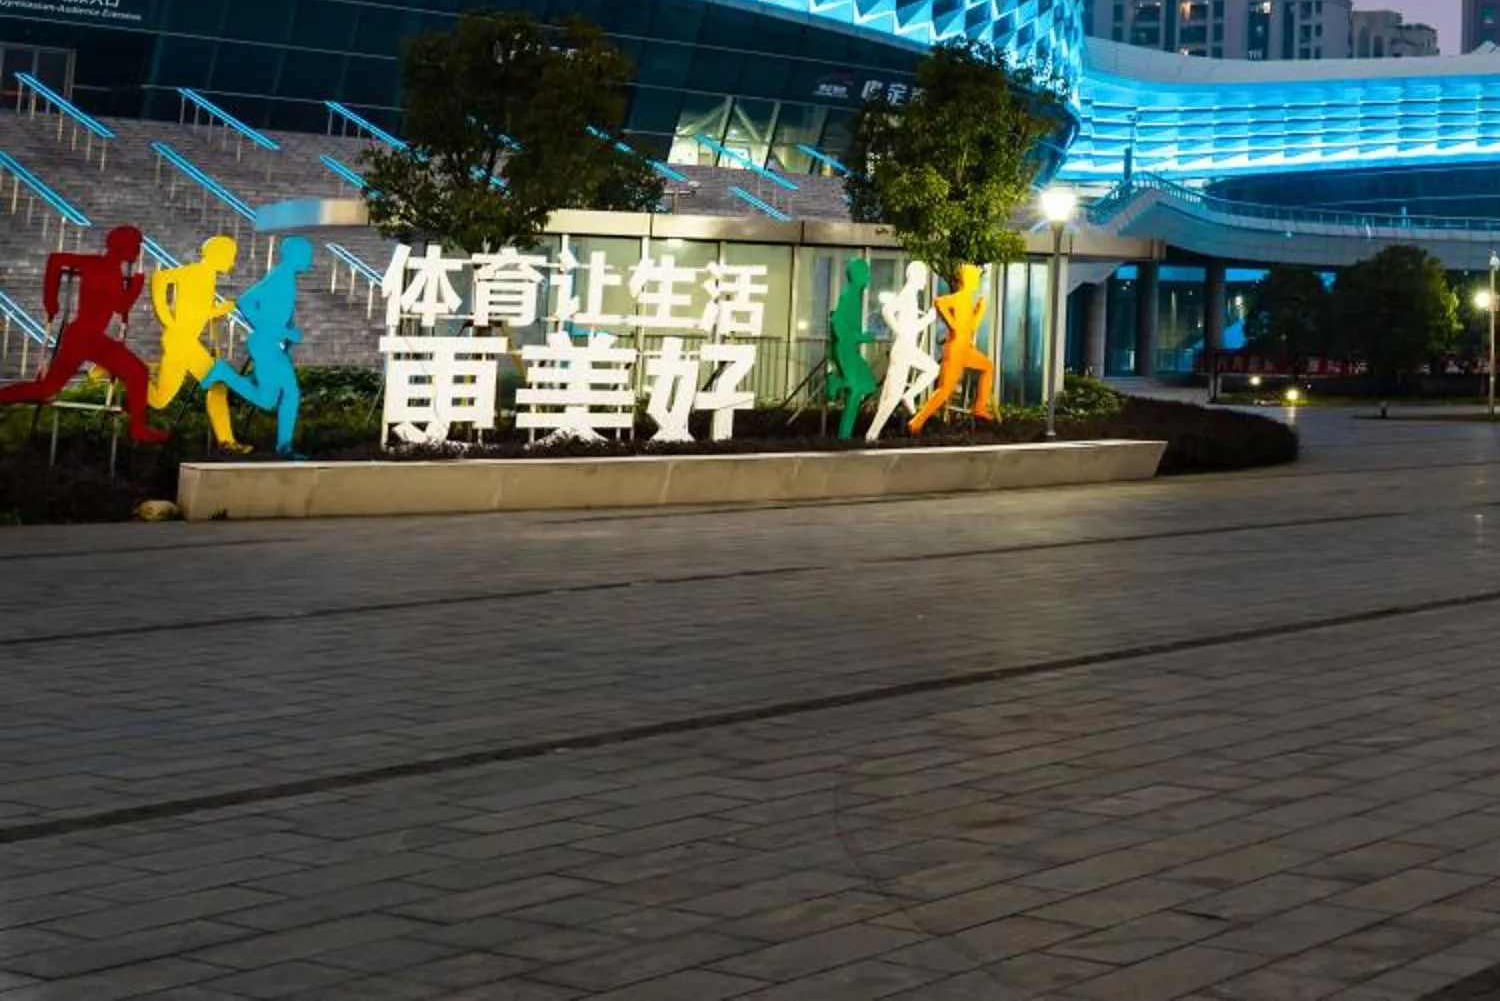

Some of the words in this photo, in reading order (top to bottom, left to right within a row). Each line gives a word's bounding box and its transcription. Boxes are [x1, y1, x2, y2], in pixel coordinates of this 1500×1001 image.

[380, 243, 769, 336] 体育让生活
[379, 332, 757, 444] 更美好
